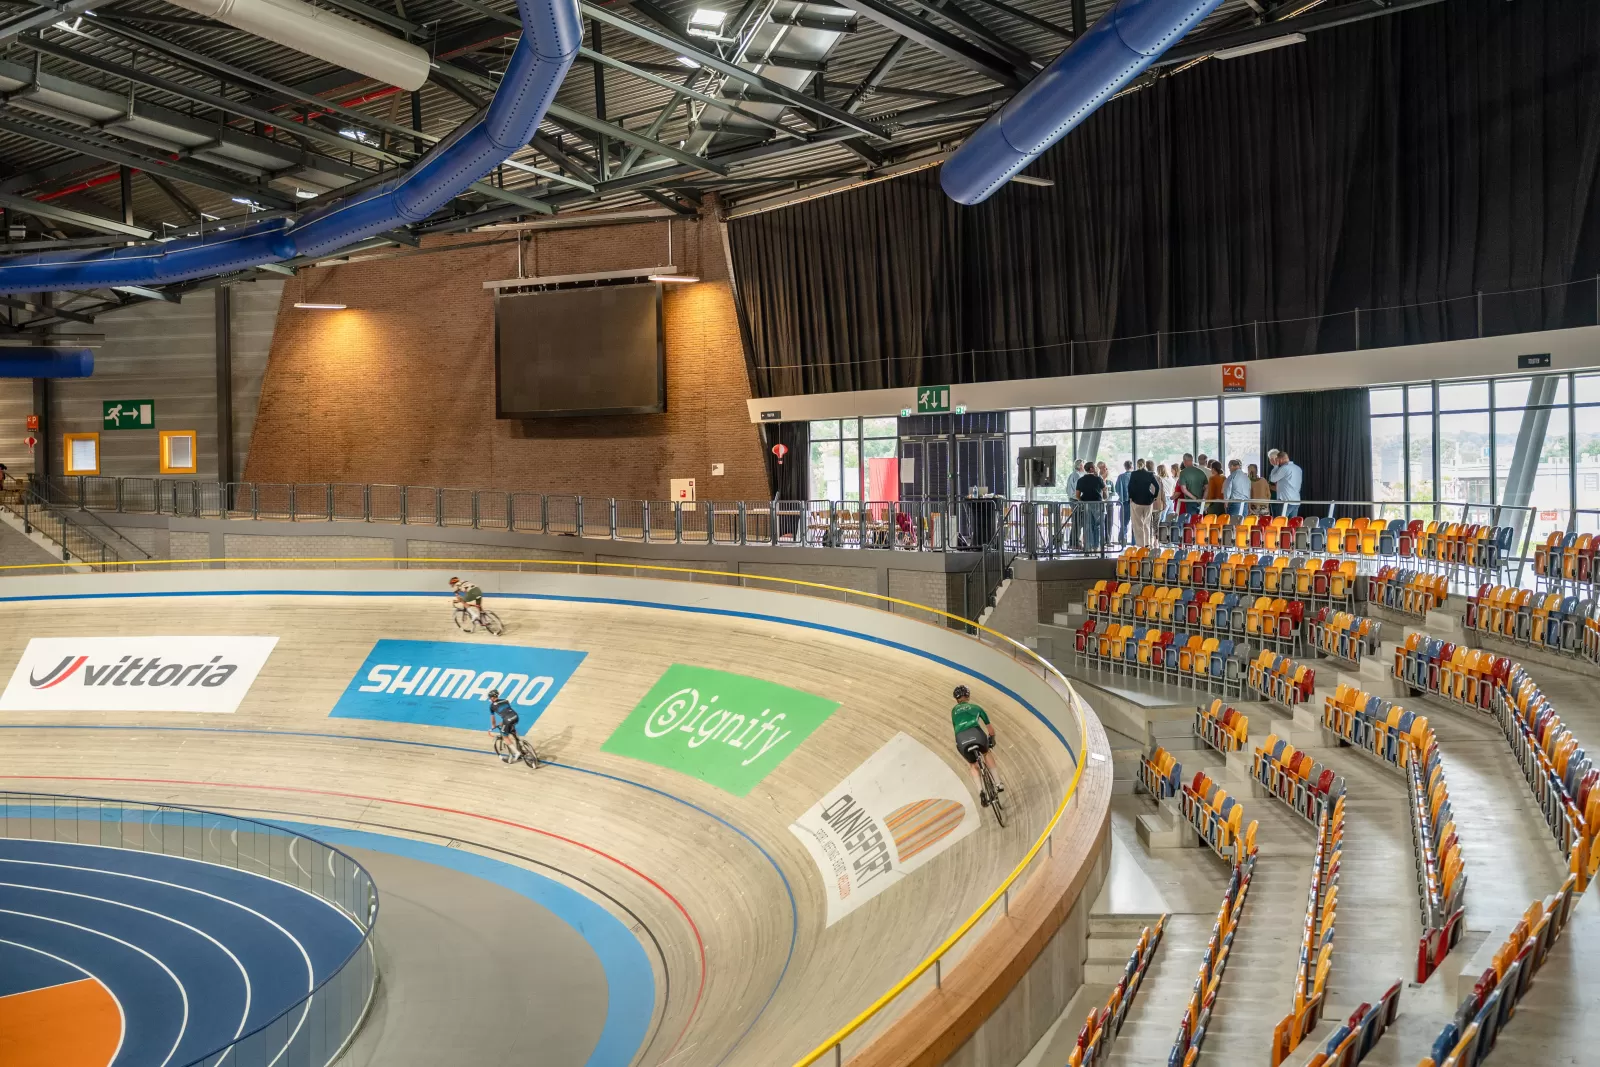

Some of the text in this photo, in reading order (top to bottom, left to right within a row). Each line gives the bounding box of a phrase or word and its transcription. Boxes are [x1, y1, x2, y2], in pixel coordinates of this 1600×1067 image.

[1233, 366, 1244, 380] Q
[83, 655, 238, 687] vittoria
[358, 664, 554, 706] SHIMANO
[821, 794, 893, 888] OMNISPORT
